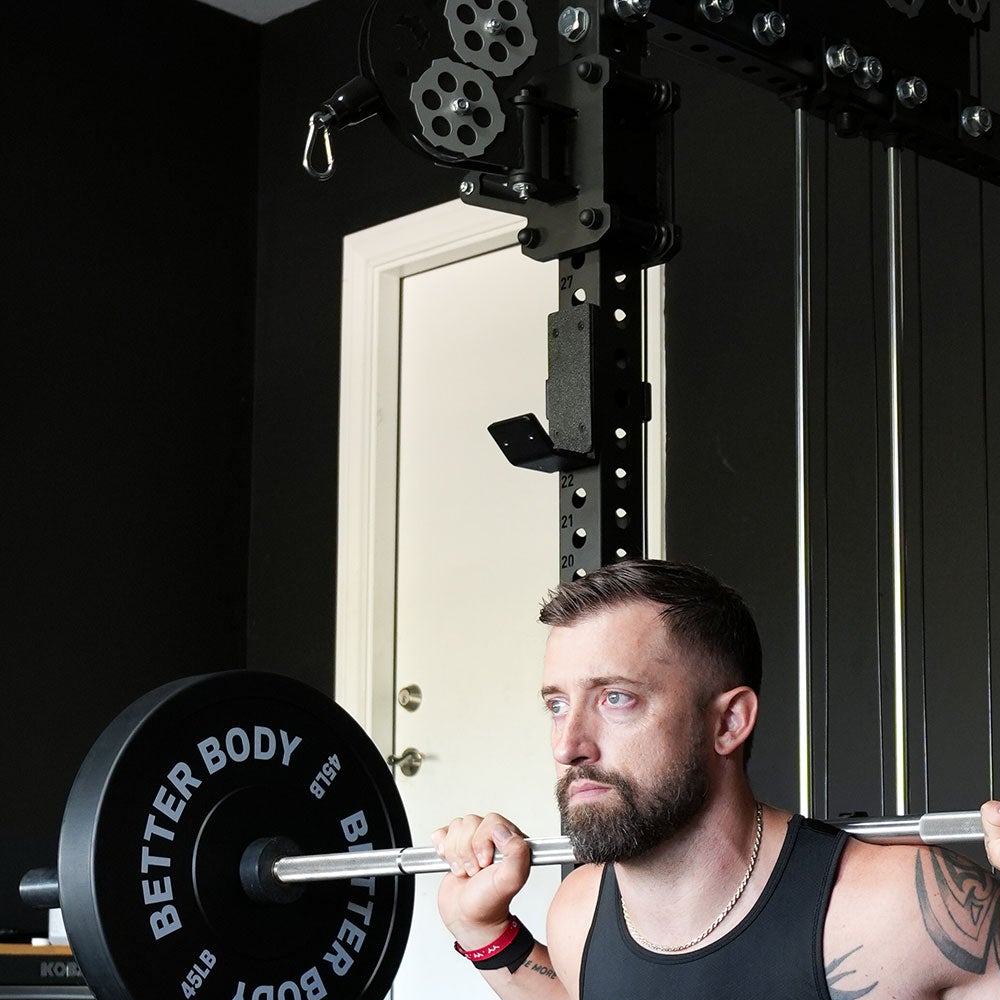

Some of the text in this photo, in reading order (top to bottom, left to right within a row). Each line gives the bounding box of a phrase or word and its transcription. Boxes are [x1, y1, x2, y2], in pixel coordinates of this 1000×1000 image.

[560, 275, 573, 291] 27
[561, 474, 574, 488] 22
[561, 514, 573, 529] 21
[561, 554, 574, 569] 20
[308, 752, 344, 800] 45LB
[141, 724, 303, 942] BETTER BODY
[322, 809, 377, 978] BTTER
